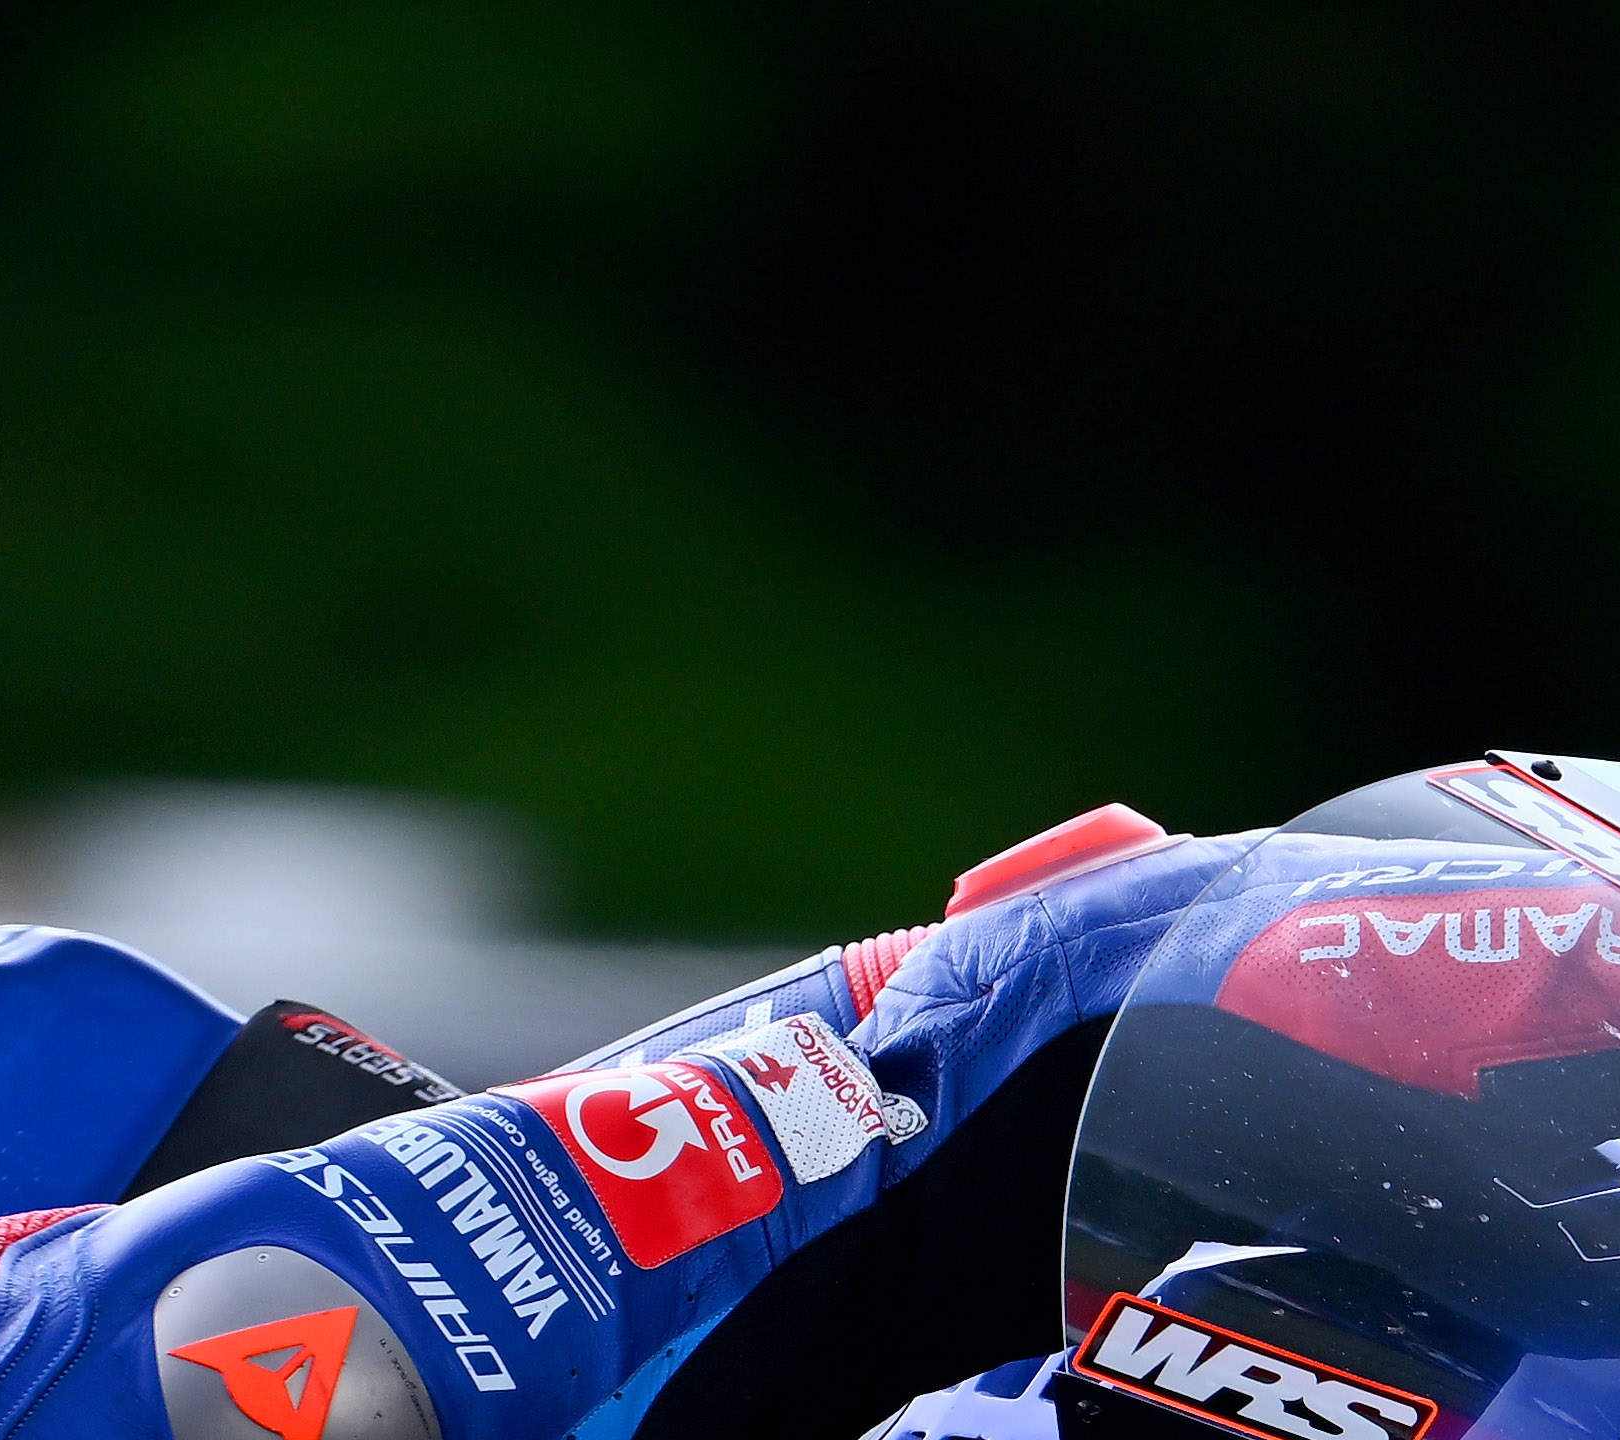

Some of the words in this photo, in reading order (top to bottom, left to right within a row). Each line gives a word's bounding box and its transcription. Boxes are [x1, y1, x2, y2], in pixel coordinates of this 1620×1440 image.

[457, 1103, 529, 1146] Compon
[670, 1069, 763, 1183] PRAM
[524, 1151, 569, 1208] Engine
[358, 1117, 570, 1340] YAMALUBE
[562, 1206, 612, 1263] Liquid
[258, 1147, 516, 1391] DAINESE
[608, 1262, 623, 1274] A
